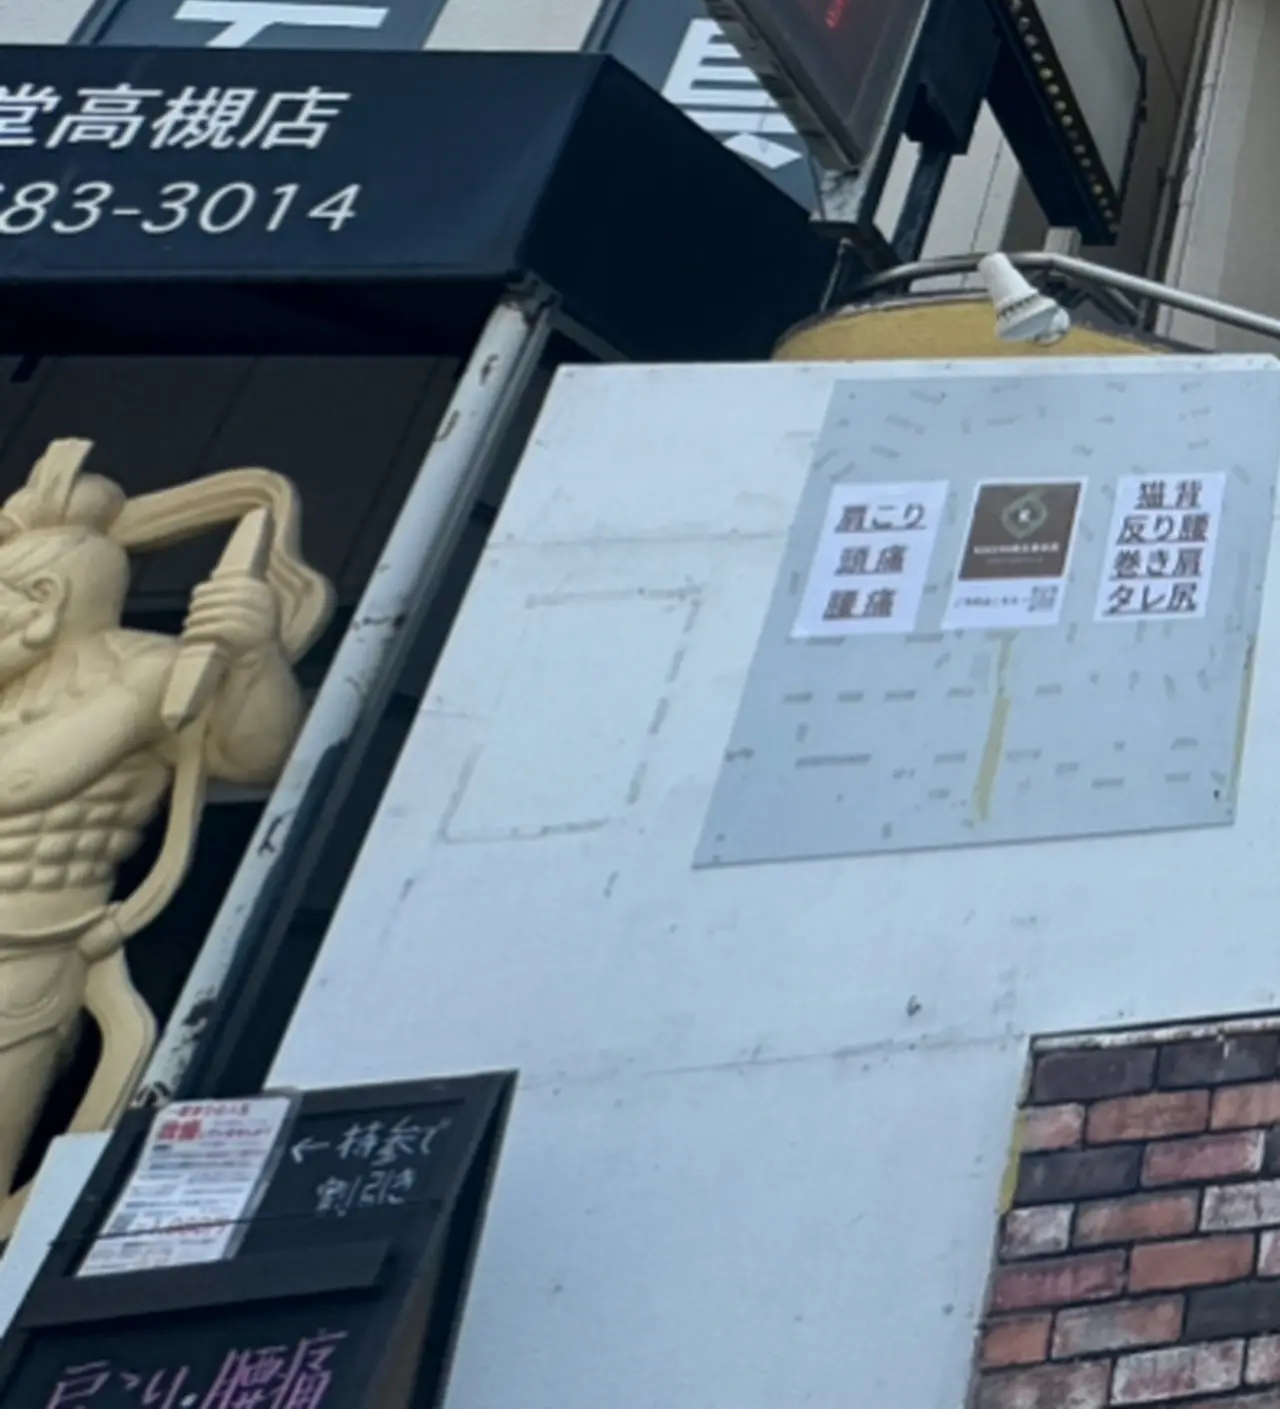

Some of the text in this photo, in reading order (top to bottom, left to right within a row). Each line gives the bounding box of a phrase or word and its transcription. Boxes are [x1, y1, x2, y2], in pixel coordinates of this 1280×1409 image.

[834, 501, 927, 532] 肩こり
[1117, 512, 1211, 543] 反り腰
[1111, 547, 1204, 579] 巻き肩
[1105, 582, 1198, 614] タレ尻
